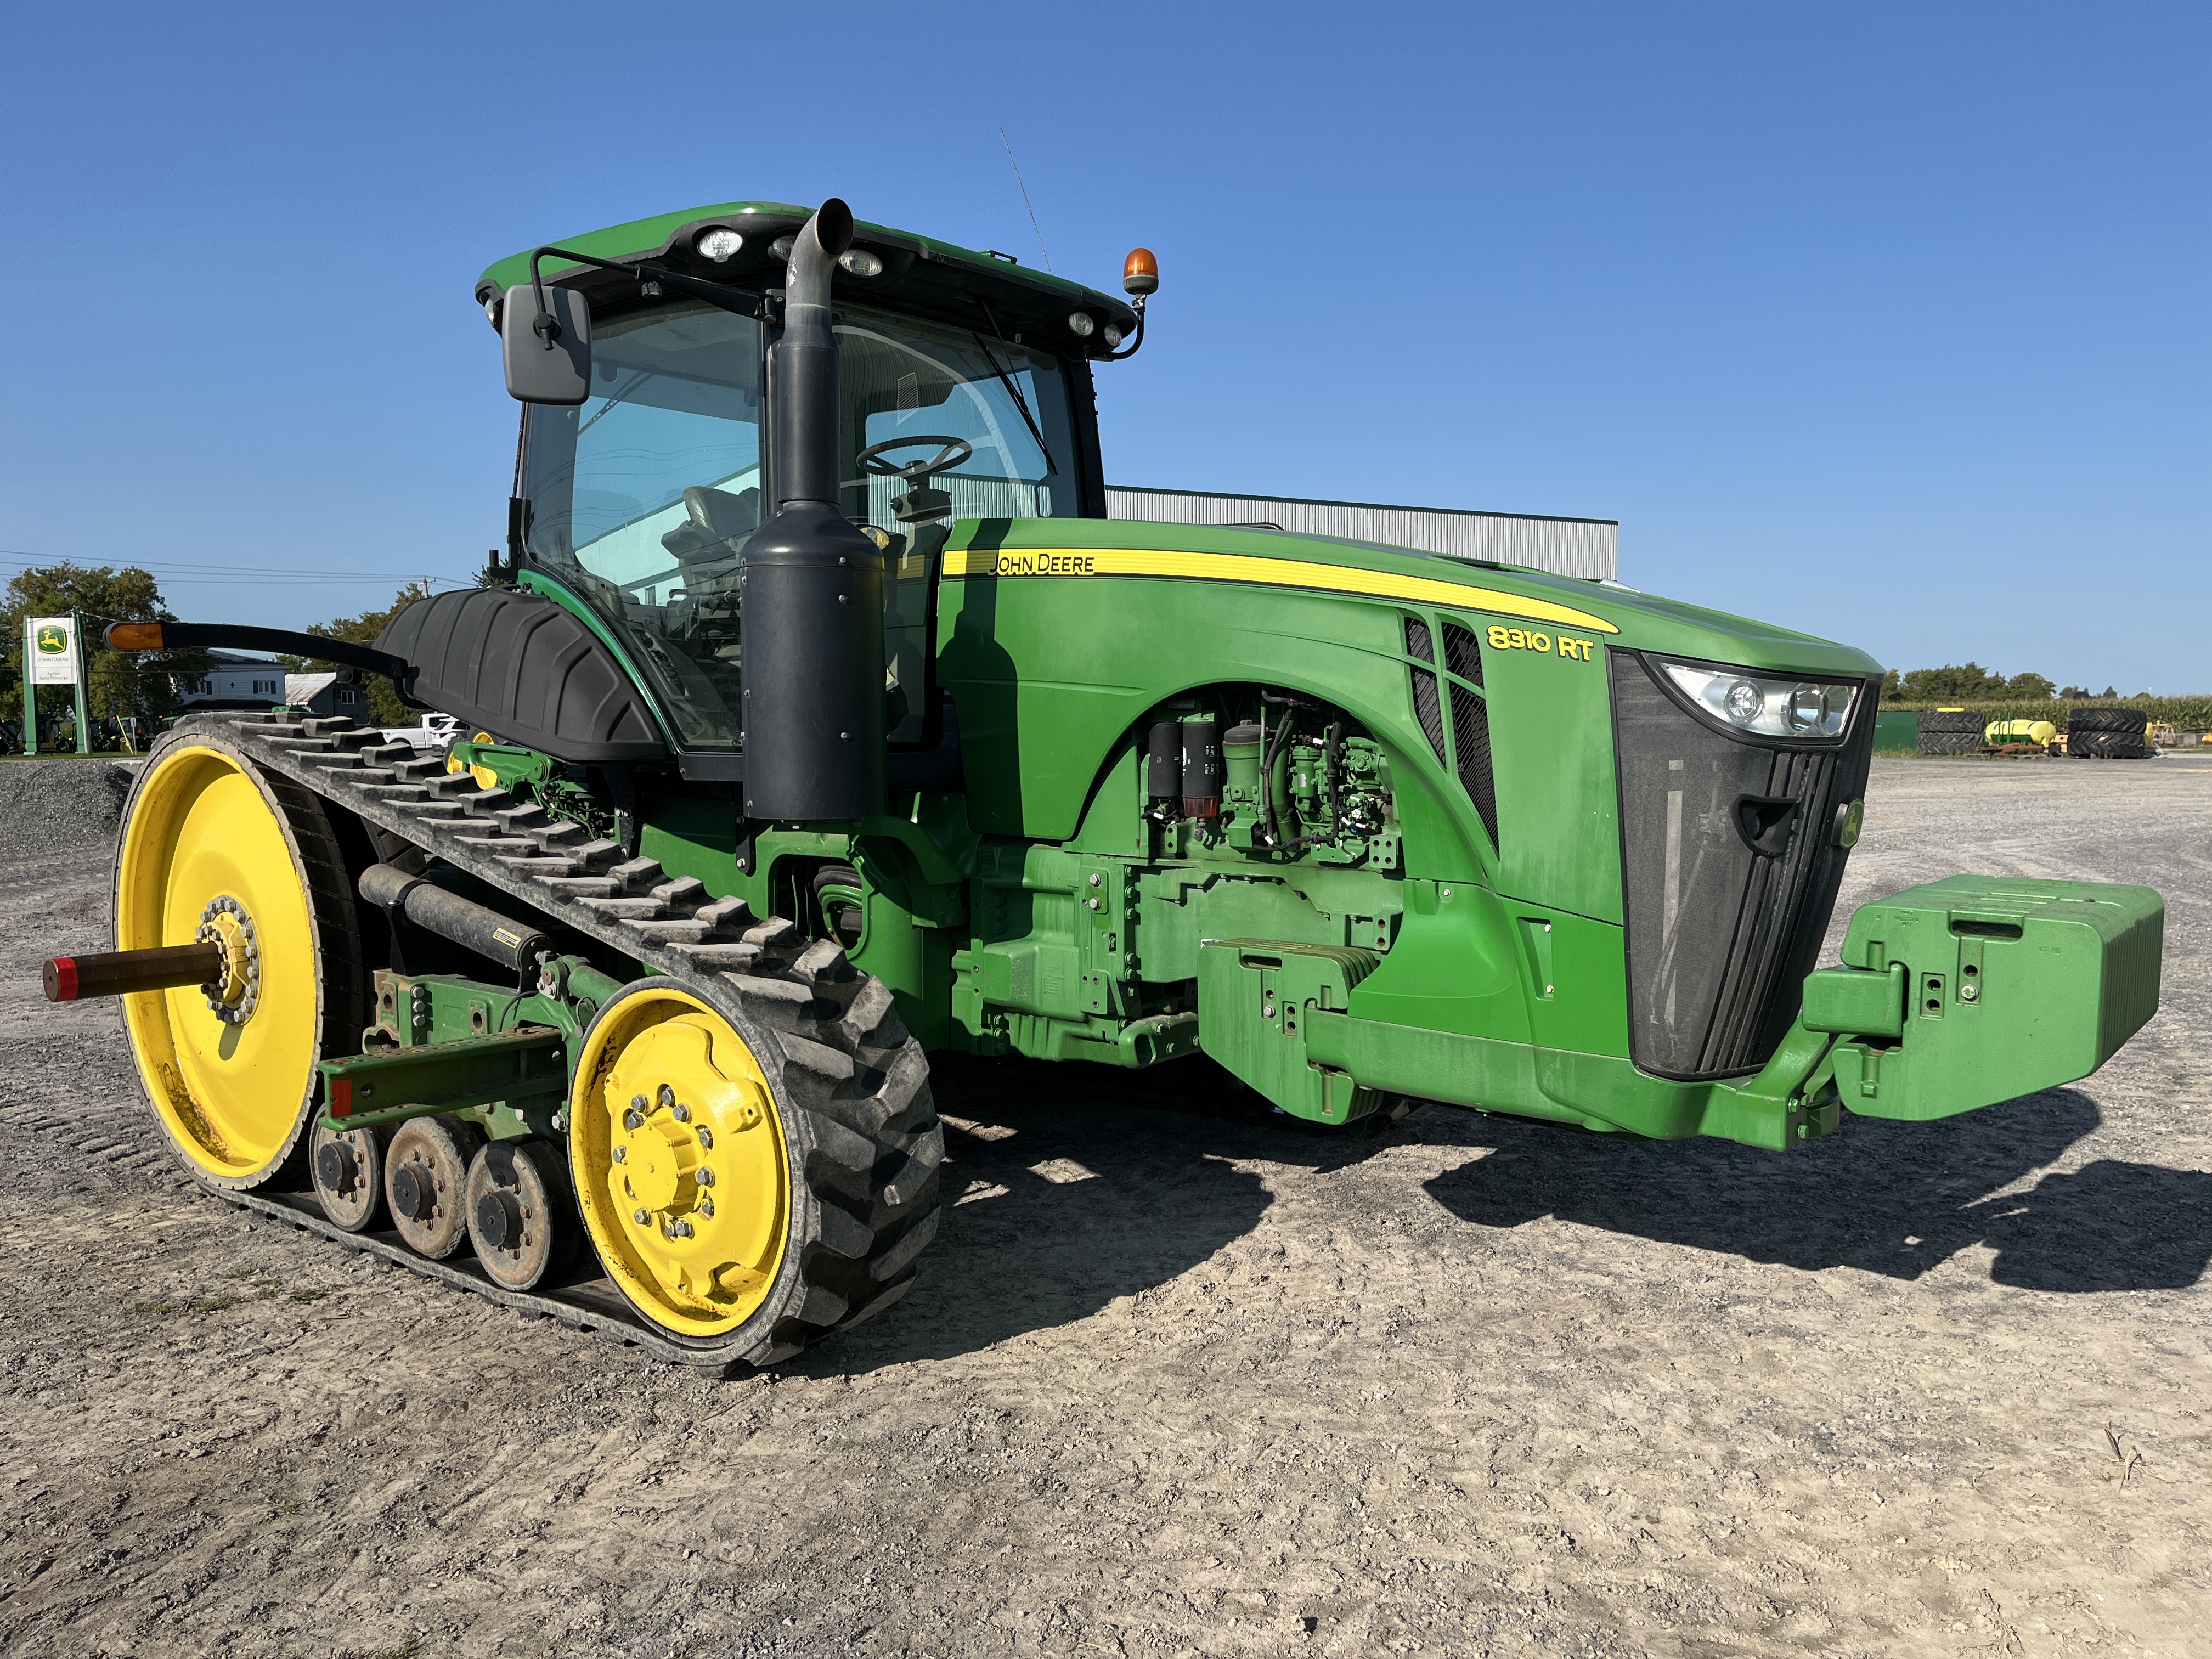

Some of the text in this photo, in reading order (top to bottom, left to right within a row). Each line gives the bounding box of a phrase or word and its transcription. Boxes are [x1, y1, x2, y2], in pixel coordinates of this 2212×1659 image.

[989, 553, 1095, 573] JOHN DEERE
[1486, 625, 1594, 663] 8310 RT
